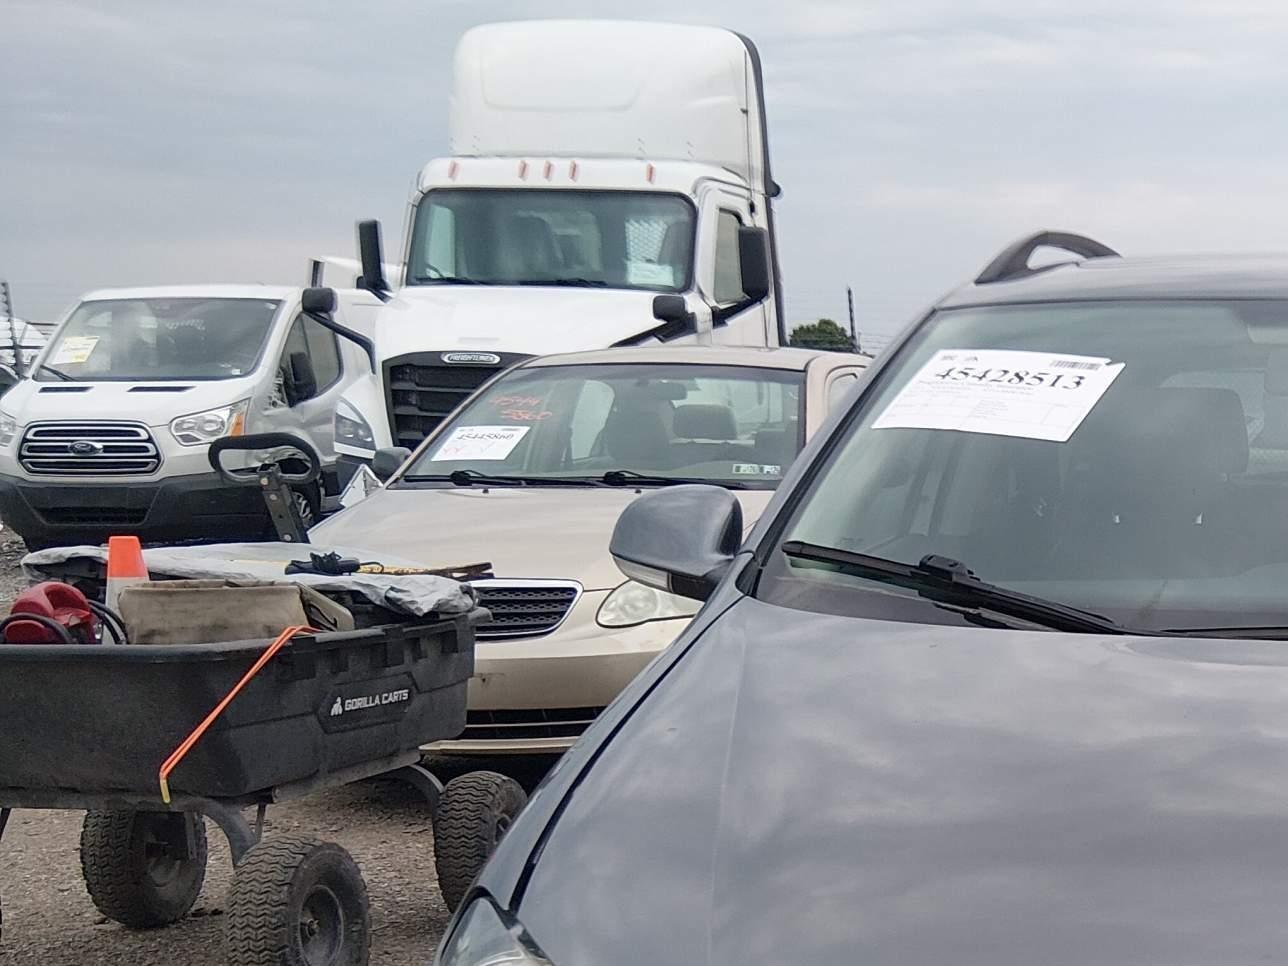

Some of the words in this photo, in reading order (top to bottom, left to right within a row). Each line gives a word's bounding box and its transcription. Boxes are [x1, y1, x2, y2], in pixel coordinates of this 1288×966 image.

[935, 366, 1086, 390] 45428513
[344, 695, 380, 711] GORILLA
[381, 689, 409, 705] CARTS
